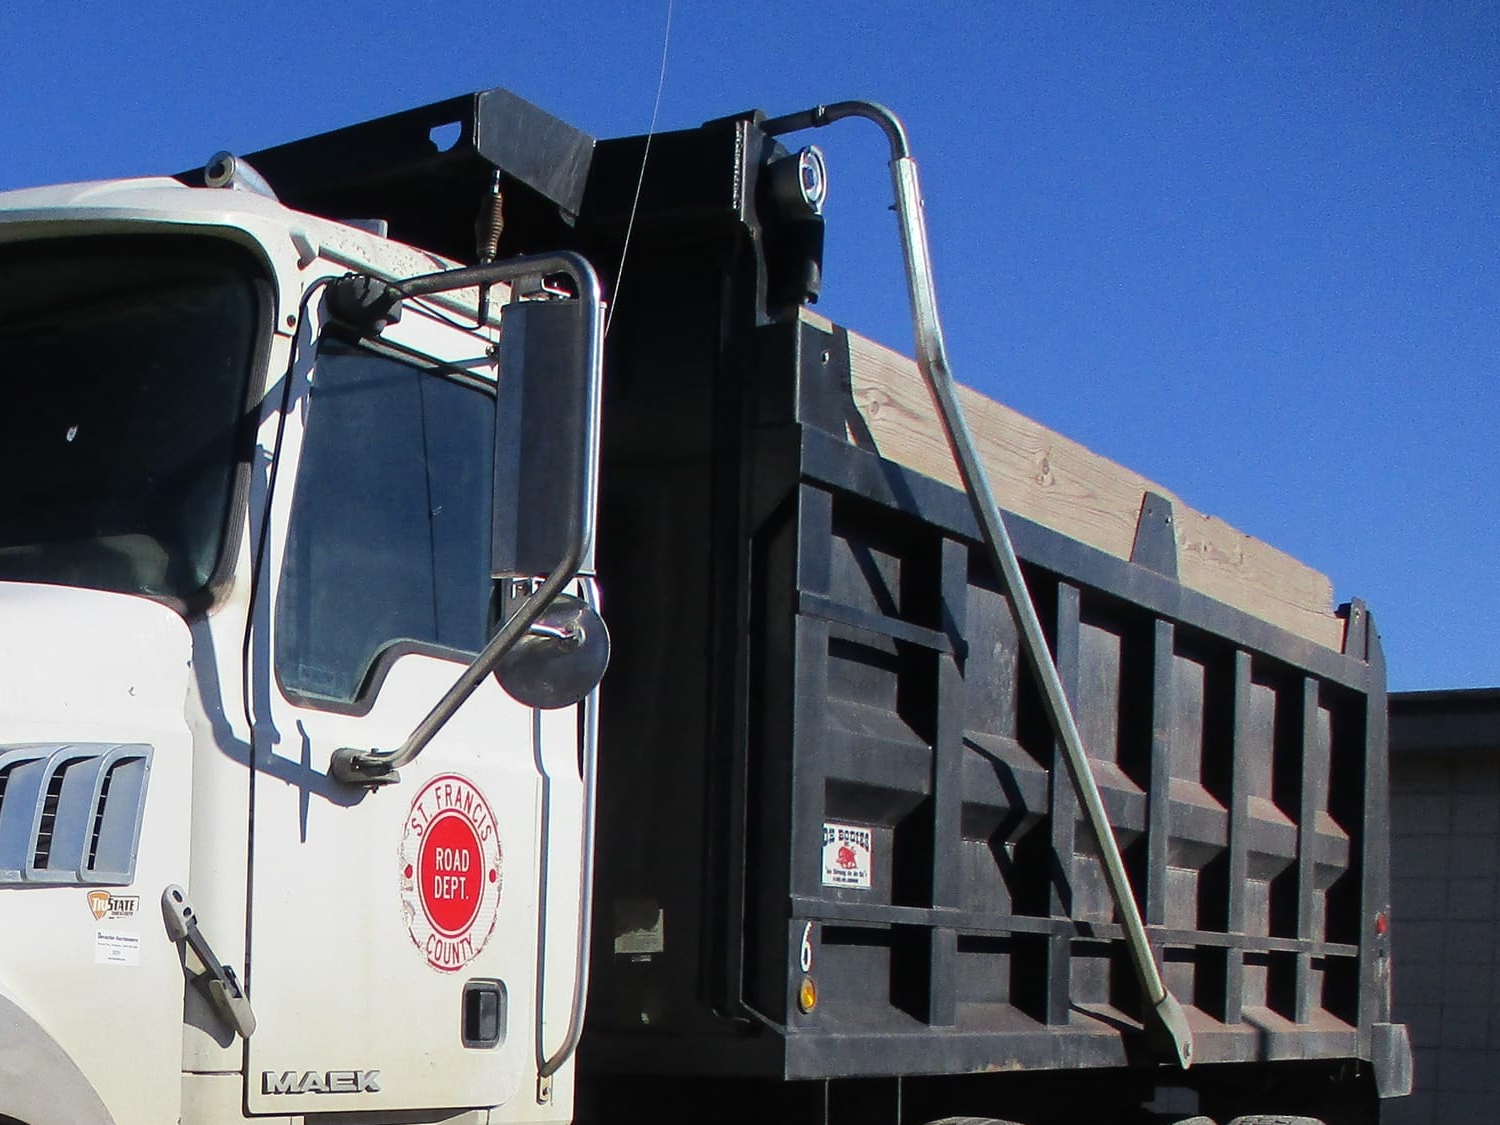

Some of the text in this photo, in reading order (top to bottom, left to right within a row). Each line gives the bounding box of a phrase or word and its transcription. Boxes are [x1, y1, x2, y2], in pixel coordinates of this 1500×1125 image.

[411, 783, 493, 842] ST. FRANCIS
[837, 829, 870, 852] BODIES
[435, 847, 470, 872] ROAD
[434, 874, 470, 900] DEPT.
[426, 932, 474, 965] COUNTY
[800, 920, 812, 972] 6
[261, 1069, 381, 1095] MACK
